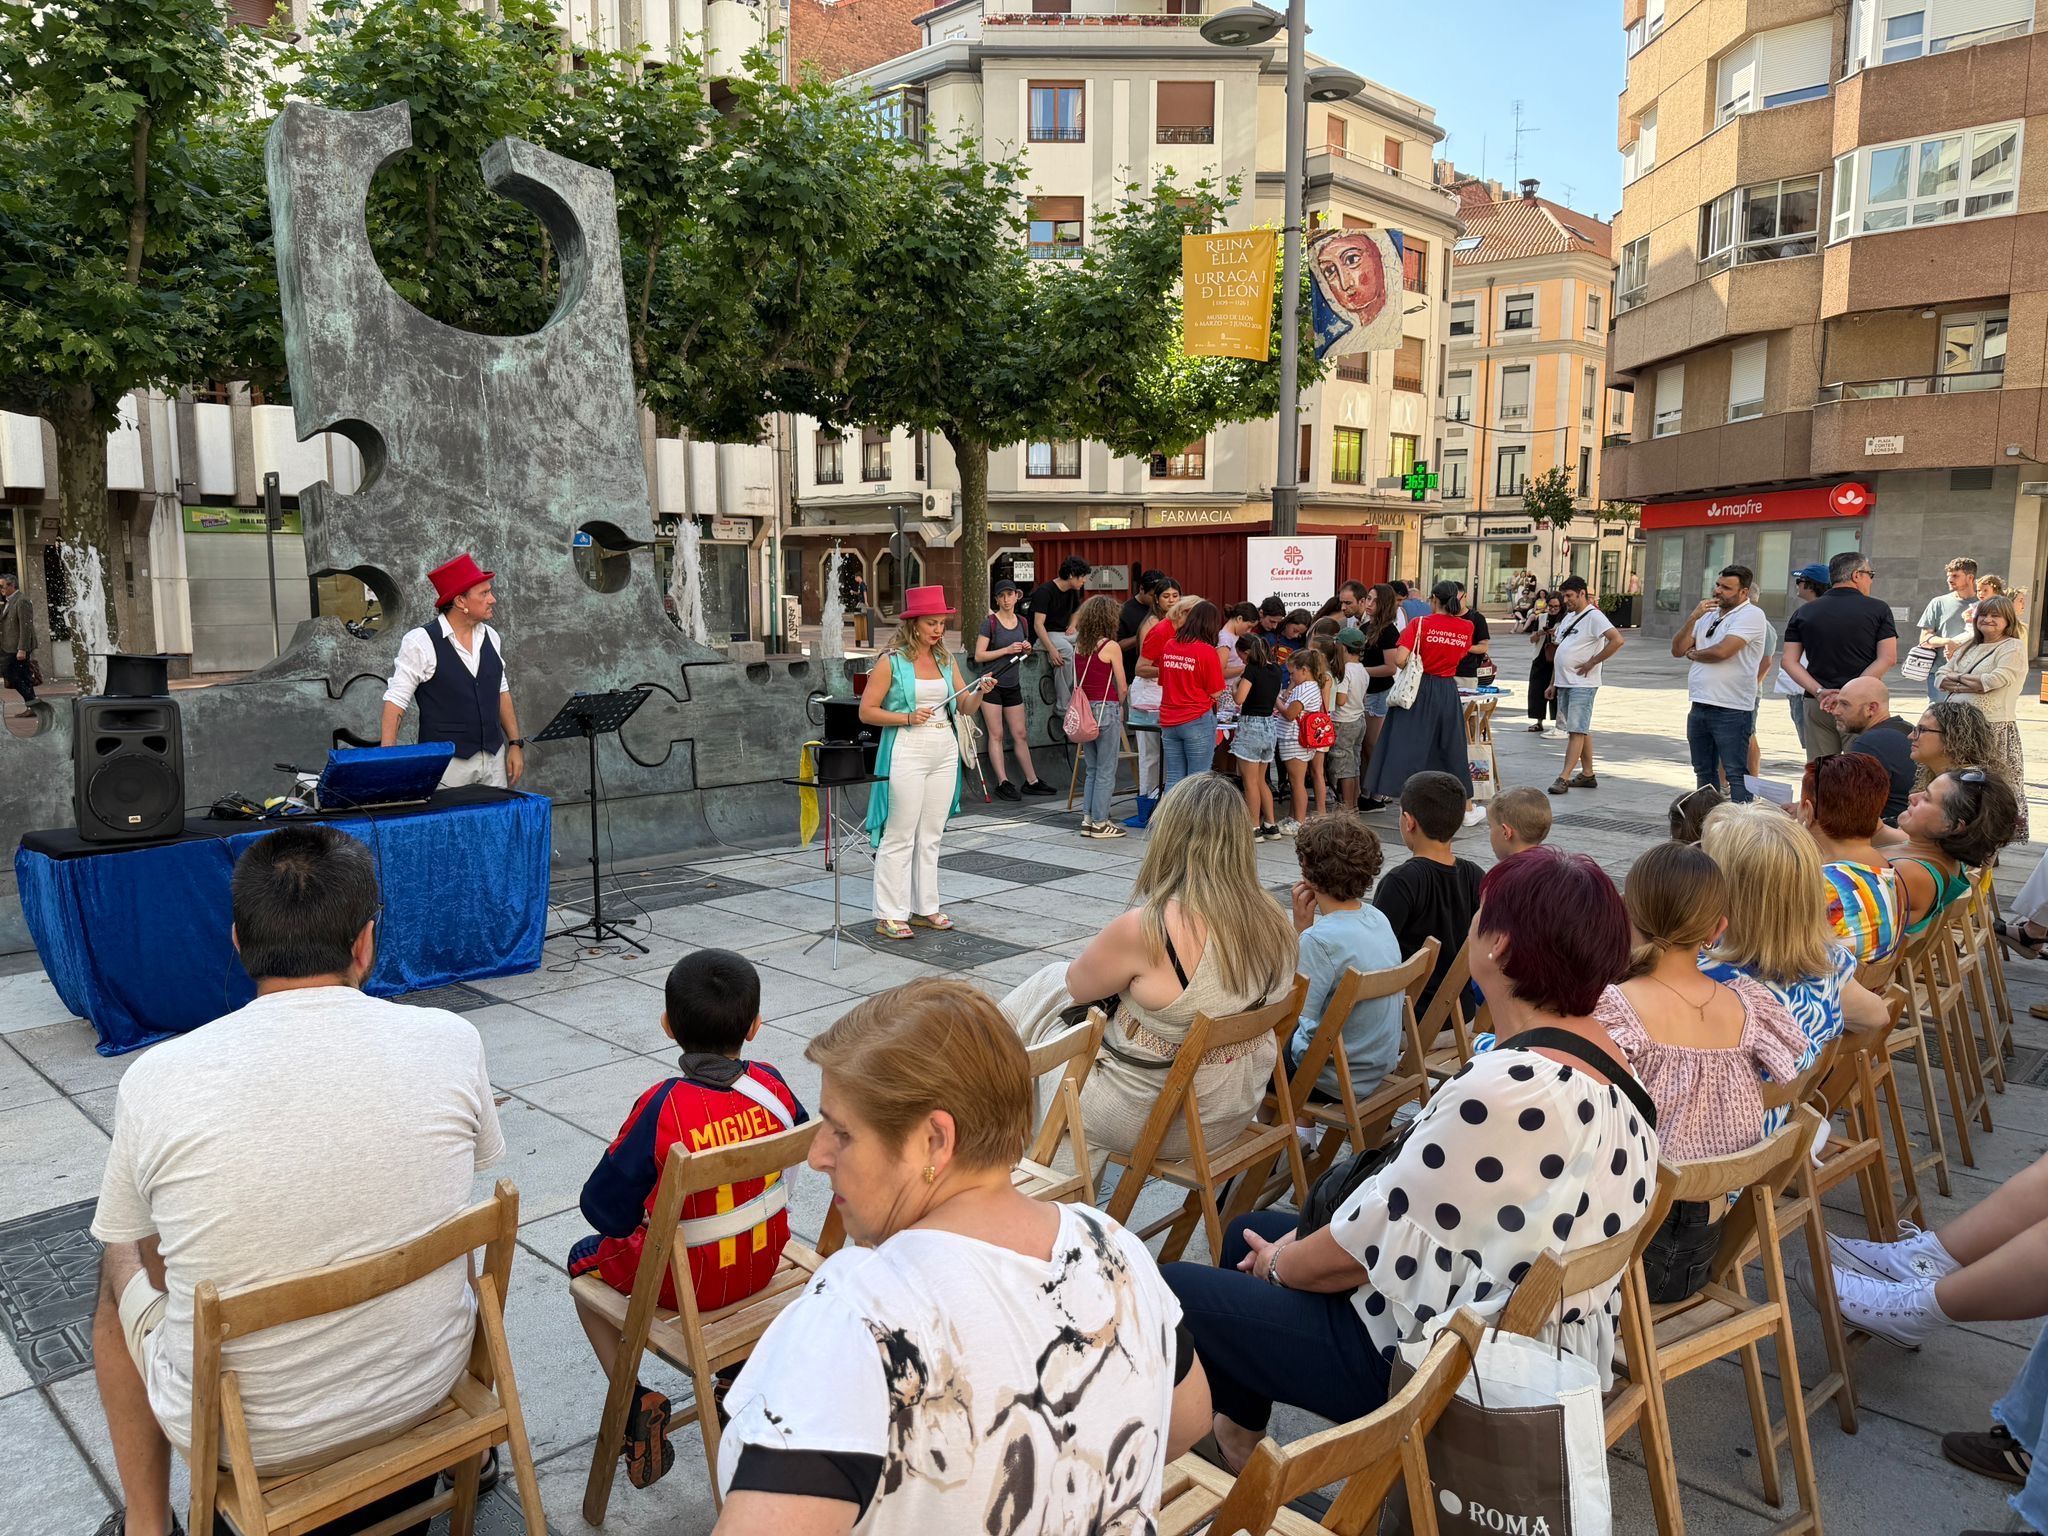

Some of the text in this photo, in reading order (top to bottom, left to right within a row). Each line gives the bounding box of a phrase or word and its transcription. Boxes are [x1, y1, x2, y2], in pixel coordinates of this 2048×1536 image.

[1206, 238, 1254, 254] REINA
[1212, 252, 1248, 266] ELLA
[1194, 269, 1259, 286] URRACA
[1218, 281, 1259, 298] LEÓN
[1405, 474, 1425, 489] 365
[1721, 499, 1763, 518] mapfre
[1160, 510, 1233, 522] FARMACIA
[1001, 522, 1048, 531] SOLERA
[1483, 524, 1532, 537] pascual
[1270, 567, 1313, 576] Cáritas
[1427, 629, 1469, 641] Jóvenes con
[1163, 653, 1196, 664] Personas con
[688, 1105, 779, 1152] MIGUEL
[1468, 1501, 1551, 1536] ROMA
